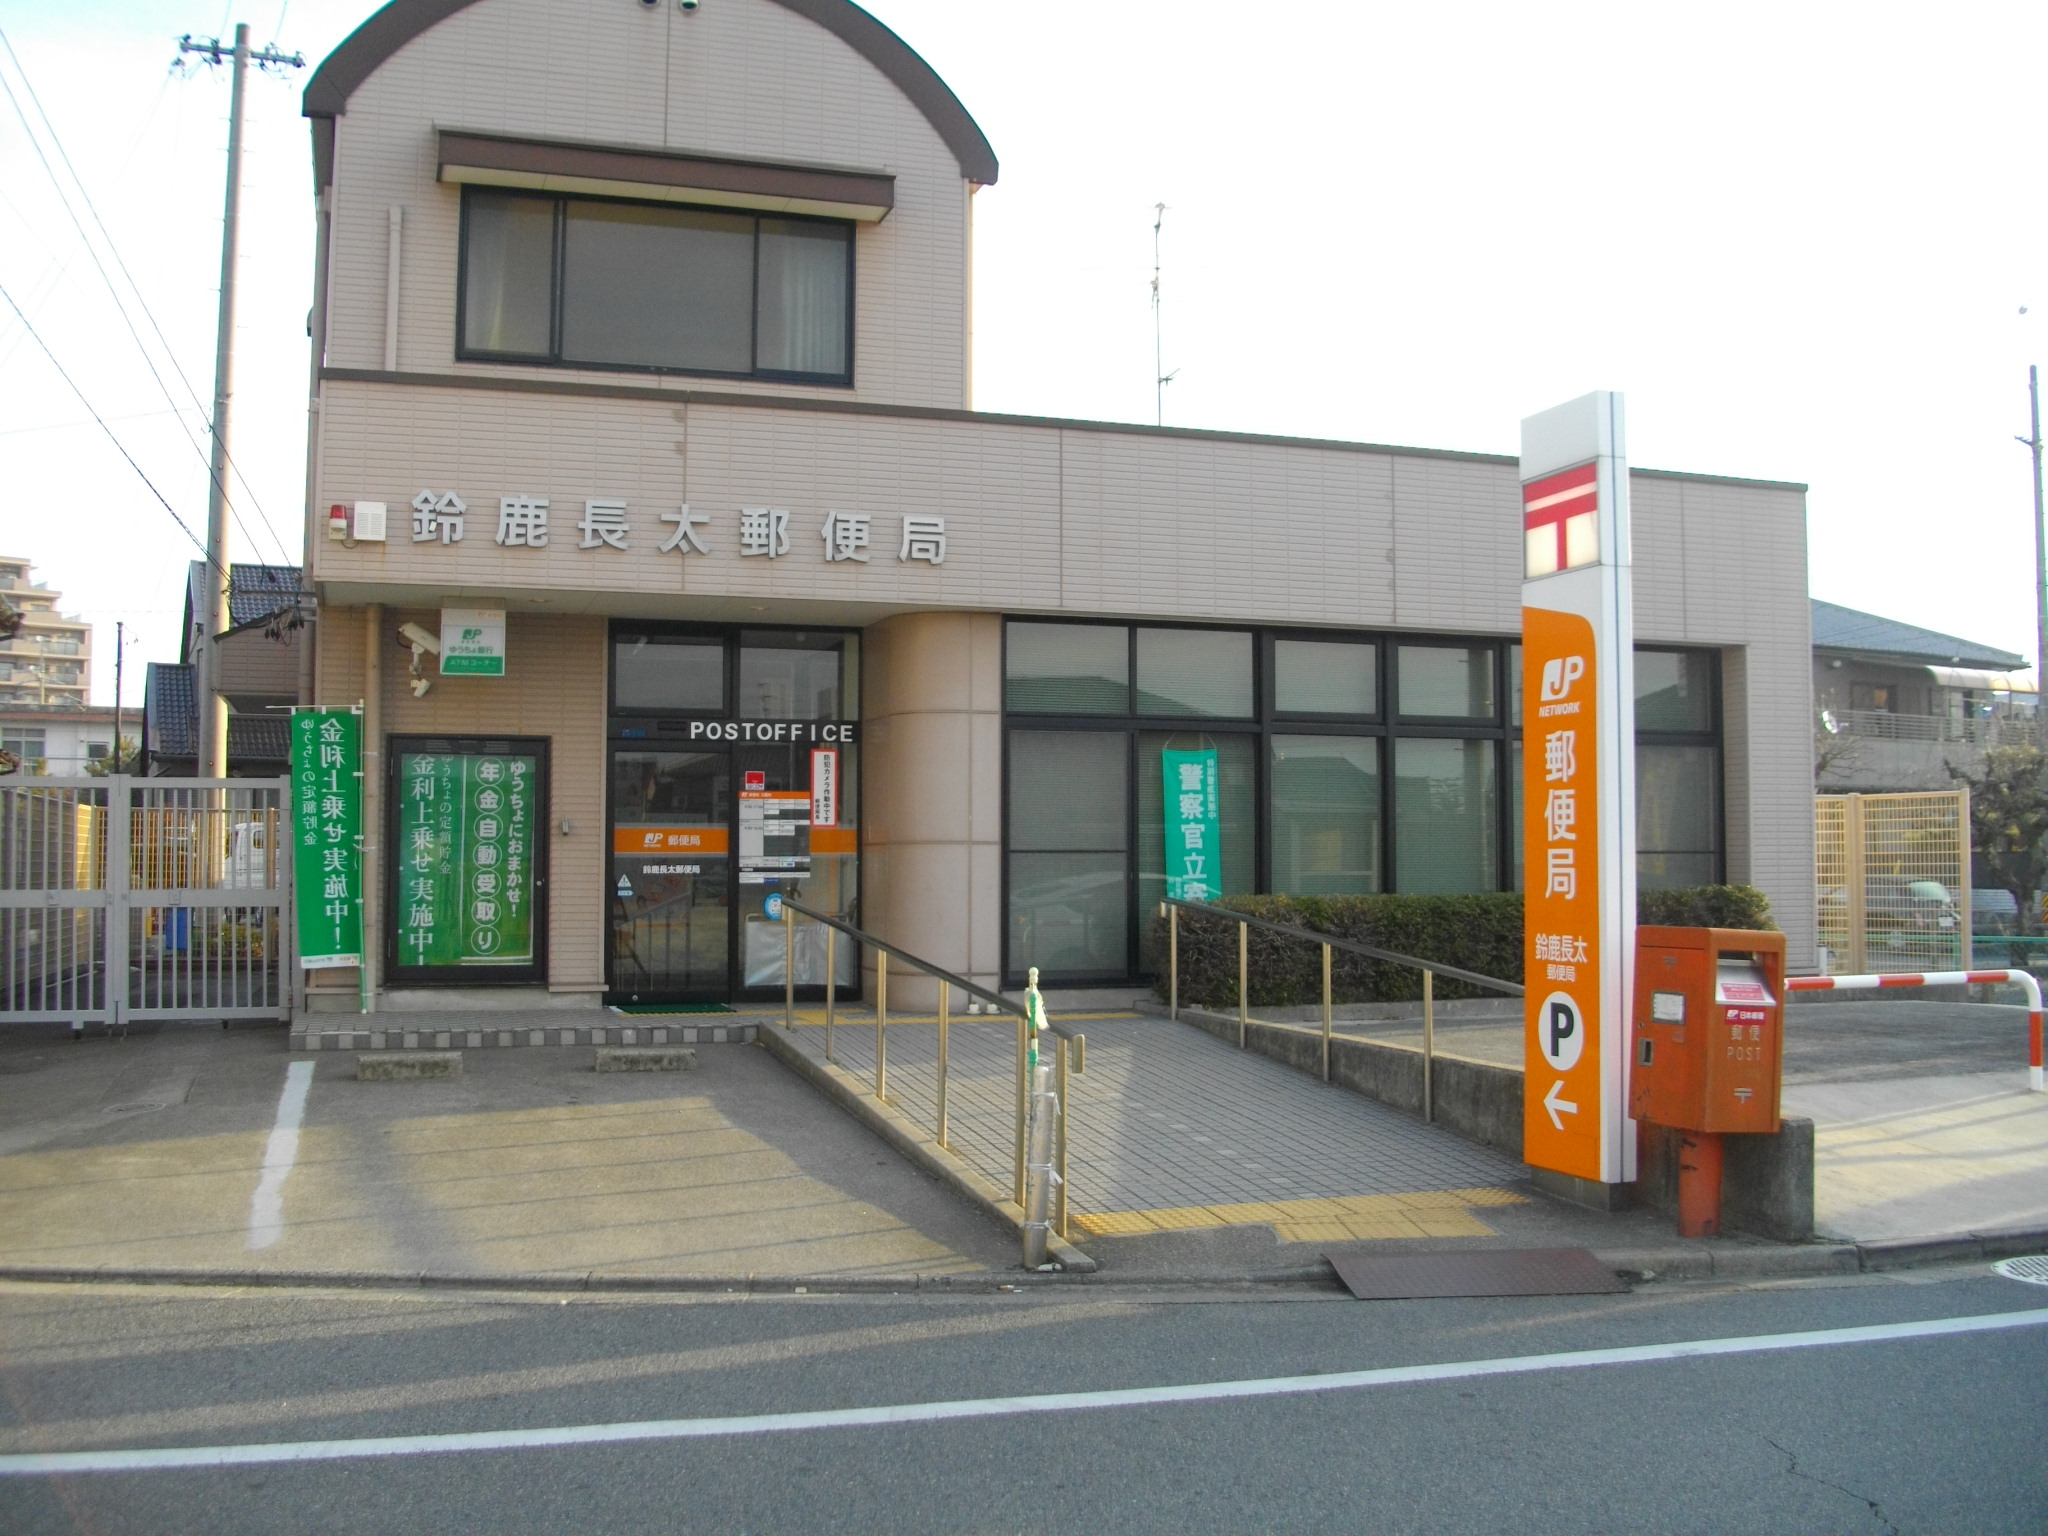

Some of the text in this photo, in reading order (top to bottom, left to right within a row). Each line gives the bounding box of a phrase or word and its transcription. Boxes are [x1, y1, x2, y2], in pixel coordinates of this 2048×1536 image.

[412, 489, 947, 566] 鈴鹿長太郵便局
[1538, 702, 1581, 718] NETWORK
[823, 754, 831, 823] 防犯カメラ作動中です
[1544, 730, 1577, 900] 郵便局
[474, 760, 502, 952] 年金自動受取り
[668, 834, 701, 847] 郵便局
[643, 865, 701, 874] 鈴鹿長太郵便局
[1535, 932, 1588, 963] 鈴鹿長太
[1546, 964, 1576, 982] 郵便局
[1550, 1002, 1575, 1057] P
[1727, 1047, 1762, 1060] POST
